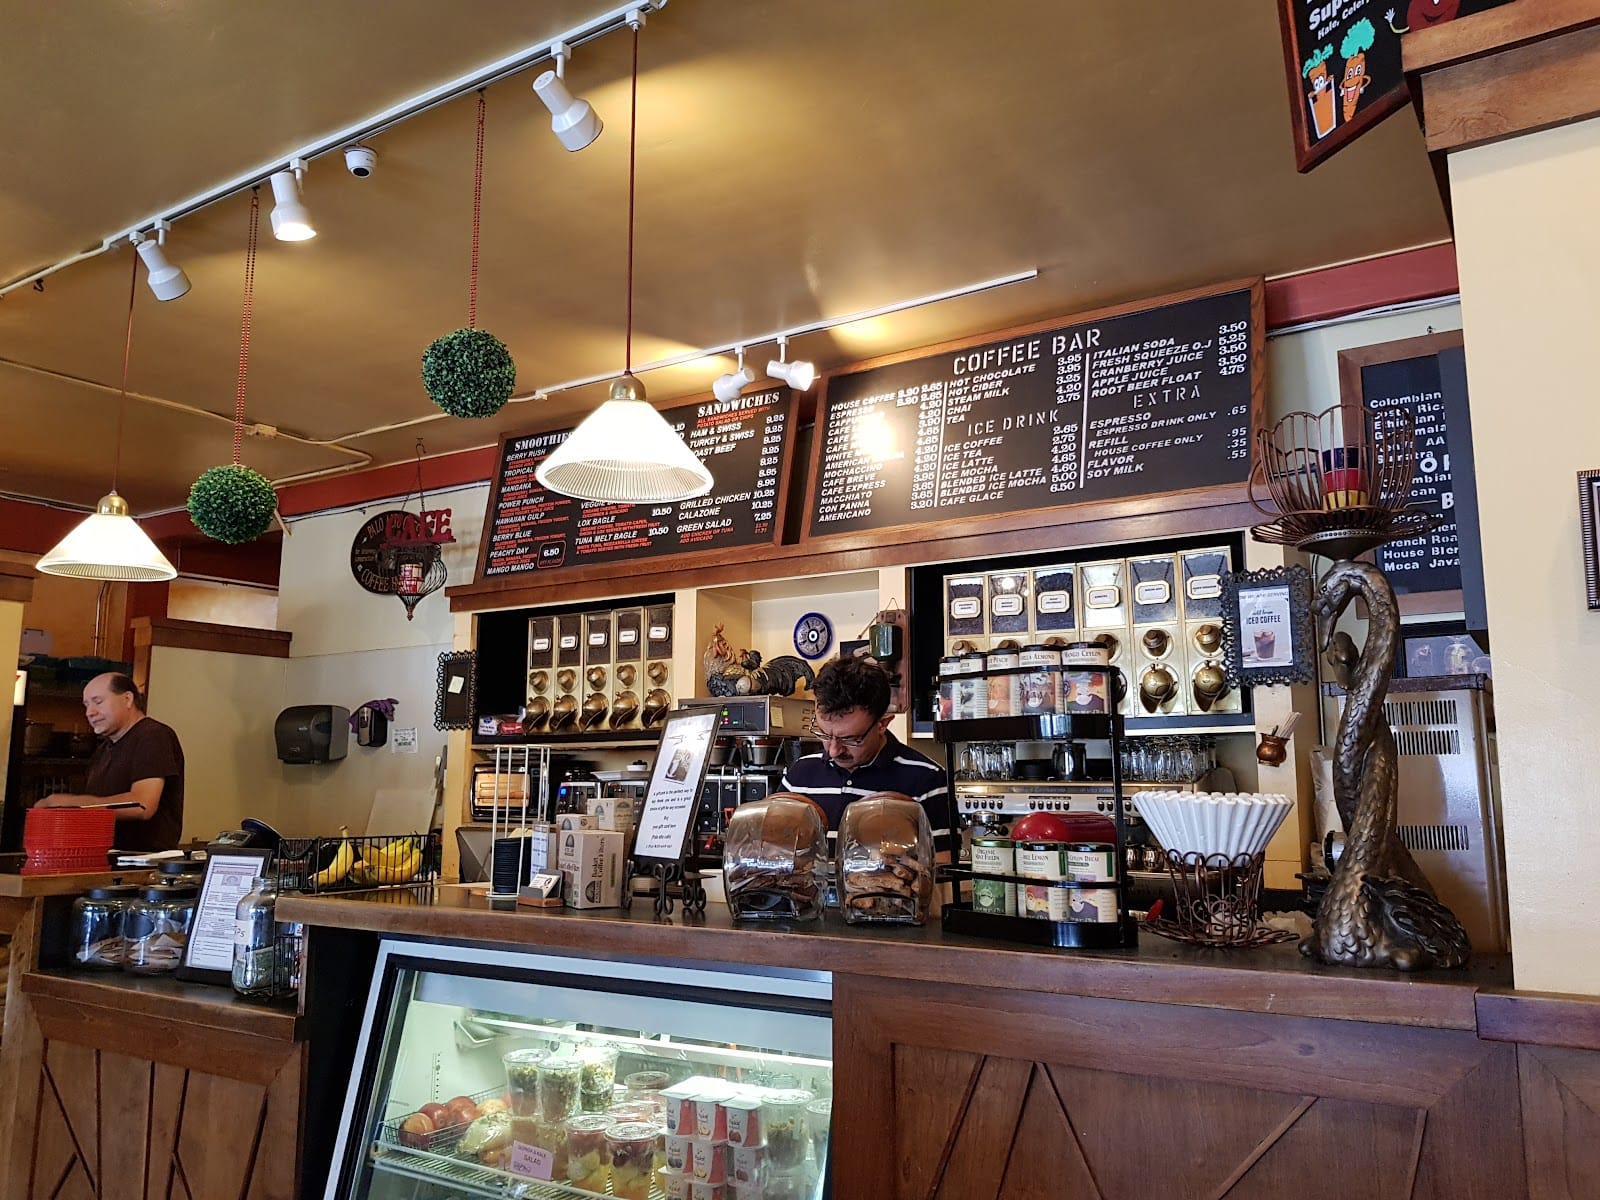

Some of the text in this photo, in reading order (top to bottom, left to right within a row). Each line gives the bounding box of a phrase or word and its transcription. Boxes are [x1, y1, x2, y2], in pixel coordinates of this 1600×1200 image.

[1218, 321, 1248, 335] 3.50
[1218, 332, 1247, 346] 5.25
[953, 328, 1101, 376] COFFEE BAR
[1092, 339, 1212, 370] FRESH SQUEEZE O.J
[1093, 337, 1175, 360] ITALIAN SODA
[1218, 341, 1248, 355] 3.50
[1057, 353, 1082, 366] 3.95
[1091, 351, 1204, 379] CRANBERRY JUICE
[1218, 353, 1248, 367] 3.50
[1057, 363, 1081, 375] 3.95
[1218, 364, 1245, 376] 4.75
[949, 363, 1037, 389] HOT CHOCOLATE
[1056, 374, 1081, 385] 3.25
[1091, 367, 1169, 389] APPLE JUICE
[948, 380, 1003, 398] HOT CIDER
[1055, 383, 1082, 395] 4.20
[1091, 371, 1203, 398] ROOT BEER FLOAT
[830, 392, 896, 412] HOUSE COFFEE
[947, 387, 1010, 408] STEAM MILK
[1056, 392, 1081, 404] 2.75
[1133, 385, 1201, 409] EXTRA
[1370, 391, 1442, 409] Colombian
[697, 391, 780, 418] SANDWICHES
[946, 404, 972, 416] CHAI
[1227, 405, 1248, 416] .65
[945, 414, 966, 425] TEA
[967, 409, 1059, 437] ICE DRINK
[1089, 412, 1152, 430] ESPRESSO
[1096, 411, 1217, 437] ESPRESSO DRINK ONLY
[690, 427, 709, 439] HAM
[709, 427, 716, 436] &
[716, 422, 743, 434] SWISS
[828, 426, 851, 437] CAFE
[1053, 423, 1079, 435] 2.65
[1227, 427, 1248, 438] .95
[689, 430, 755, 449] TURKEY & SWISS
[827, 434, 850, 446] CAFE
[944, 436, 1004, 453] ICE COFFEE
[1052, 433, 1076, 445] 2.75
[1088, 436, 1129, 450] REFILL
[1227, 438, 1248, 449] .35
[714, 443, 737, 454] BEEF
[826, 443, 849, 455] CAFE
[1051, 443, 1077, 455] 4.20
[1094, 434, 1204, 458] HOUSE COFFEE ONLY
[506, 452, 528, 462] BERRY
[528, 449, 546, 458] RUSH
[825, 451, 853, 462] WHITE
[943, 449, 982, 462] ICE TEA
[1051, 453, 1076, 464] 4.65
[1227, 449, 1248, 460] .55
[942, 456, 995, 471] ICE LATTE
[1051, 462, 1077, 474] 4.60
[1087, 455, 1135, 469] FLAVOR
[504, 467, 534, 477] TROPICAL
[823, 462, 883, 479] MOCHACCINO
[941, 465, 999, 480] ICE MOCHA
[1051, 471, 1077, 483] 5.00
[1086, 463, 1145, 480] SOY MILK
[822, 473, 876, 488] CAFE BREVE
[940, 467, 1043, 489] BLENDED ICE LATTE
[501, 482, 532, 493] MANGANA
[821, 480, 887, 497] CAFE EXPRESS
[940, 476, 1047, 498] BLENDED ICE MOCHA
[1050, 481, 1076, 493] 6.50
[680, 492, 752, 510] GRILLED CHICKEN
[752, 489, 775, 500] 10.25
[820, 490, 873, 506] MACCHIATO
[911, 489, 934, 501] 3.65
[940, 491, 1004, 507] CAFE GLACE
[498, 499, 522, 509] POWER
[522, 496, 545, 506] PUNCH
[751, 500, 773, 510] 10.25
[818, 499, 870, 514] CON PANNA
[910, 499, 933, 510] 3.20
[651, 506, 673, 517] 10.50
[678, 507, 721, 520] CALAZONE
[754, 512, 773, 522] 7.25
[818, 508, 872, 523] AMERICANO
[495, 514, 526, 525] HAWAIIAN
[526, 512, 545, 521] GULP
[577, 520, 591, 528] LOX
[591, 515, 617, 525] BAGLE
[384, 508, 453, 543] CAFE
[647, 526, 669, 537] 10.50
[676, 518, 732, 534] GREEN SALAD
[492, 532, 515, 542] BERRY
[514, 530, 532, 539] BLUE
[575, 537, 593, 545] TUNA
[593, 534, 613, 543] MELT
[613, 531, 638, 540] BAGLE
[490, 547, 529, 558] PEACHY DAY
[543, 547, 560, 557] 6.50
[1383, 549, 1425, 560] House
[487, 563, 535, 575] MANGO MANGO
[1384, 562, 1420, 572] Moca
[1246, 614, 1281, 625] ICED COFFEE
